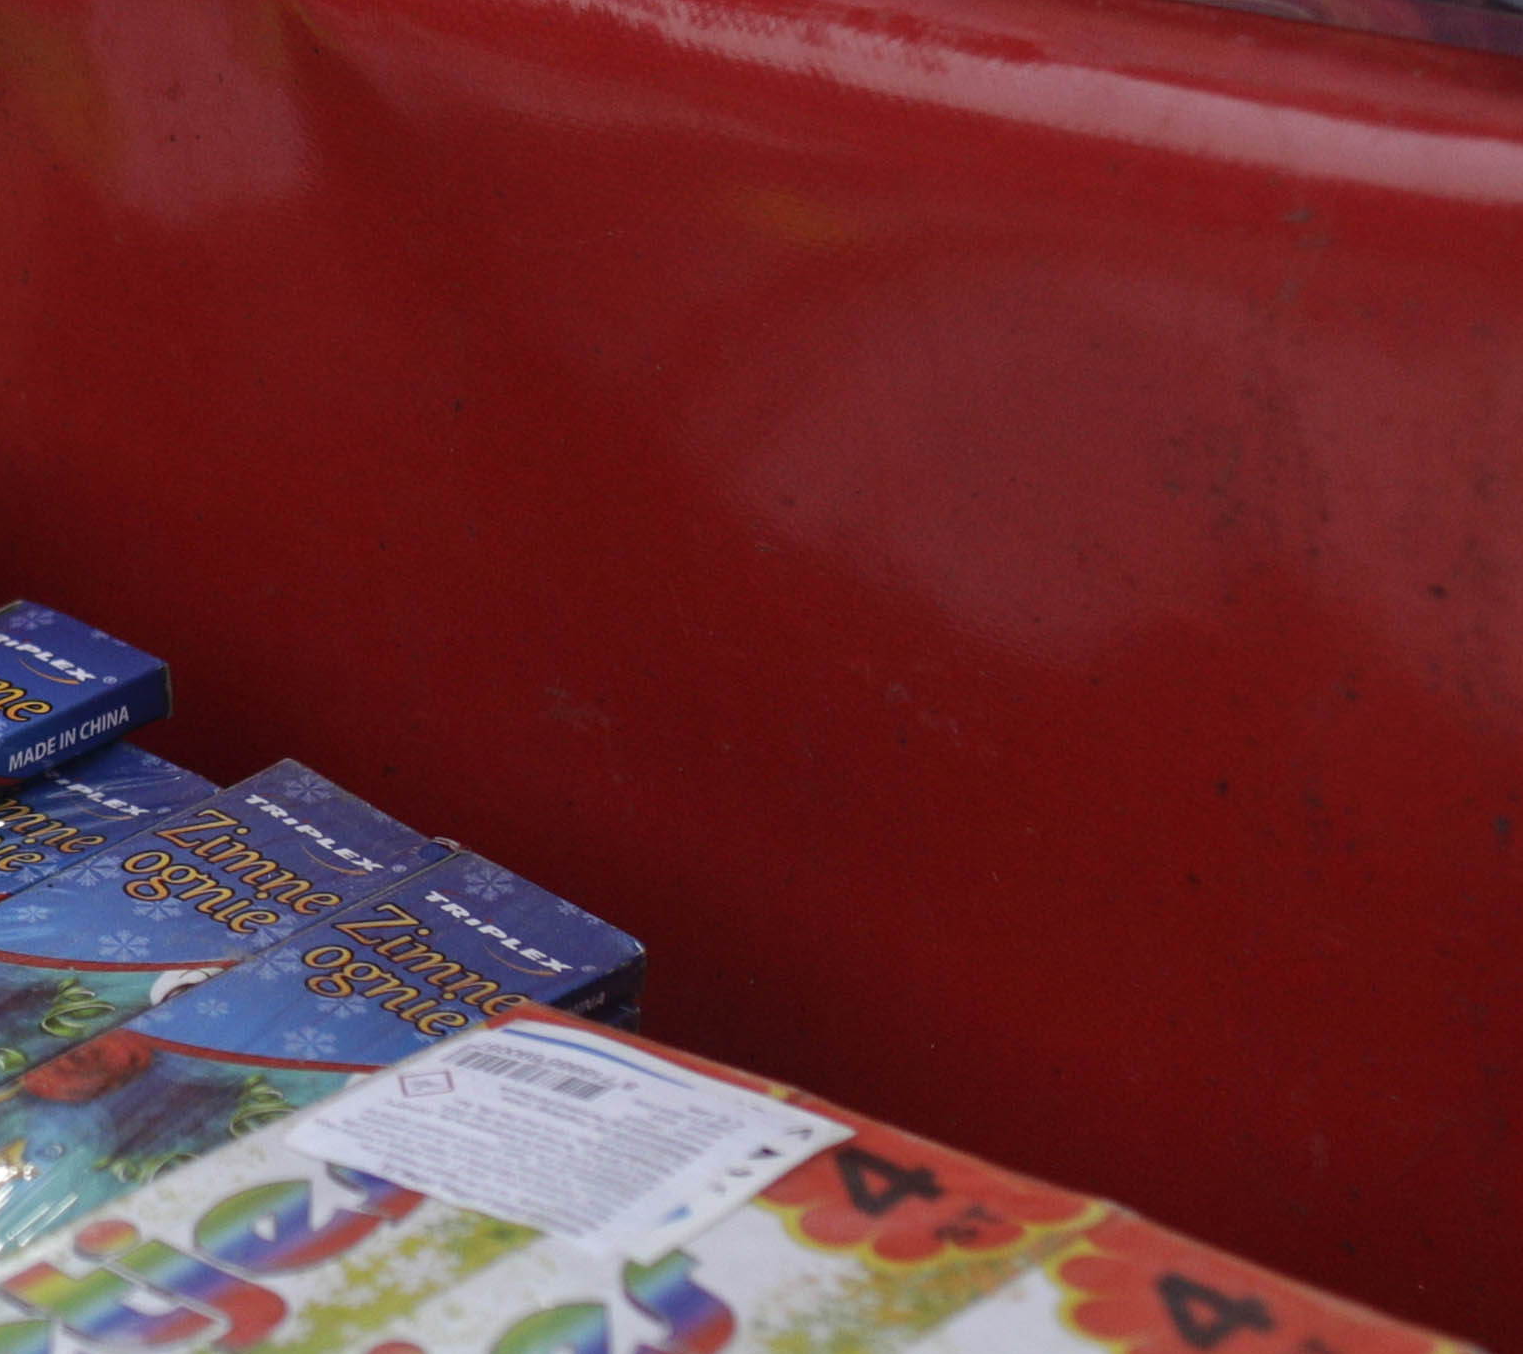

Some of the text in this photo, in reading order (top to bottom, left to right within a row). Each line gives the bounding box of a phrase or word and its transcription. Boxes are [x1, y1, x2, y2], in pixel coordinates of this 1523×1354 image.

[9, 706, 129, 772] MADE IN CHINA
[122, 849, 280, 934] ognie
[155, 809, 342, 917] Zimne
[301, 945, 471, 1037] ognie
[334, 903, 532, 1018] Zimne
[835, 1146, 940, 1219] 4
[1157, 1275, 1274, 1354] 4
